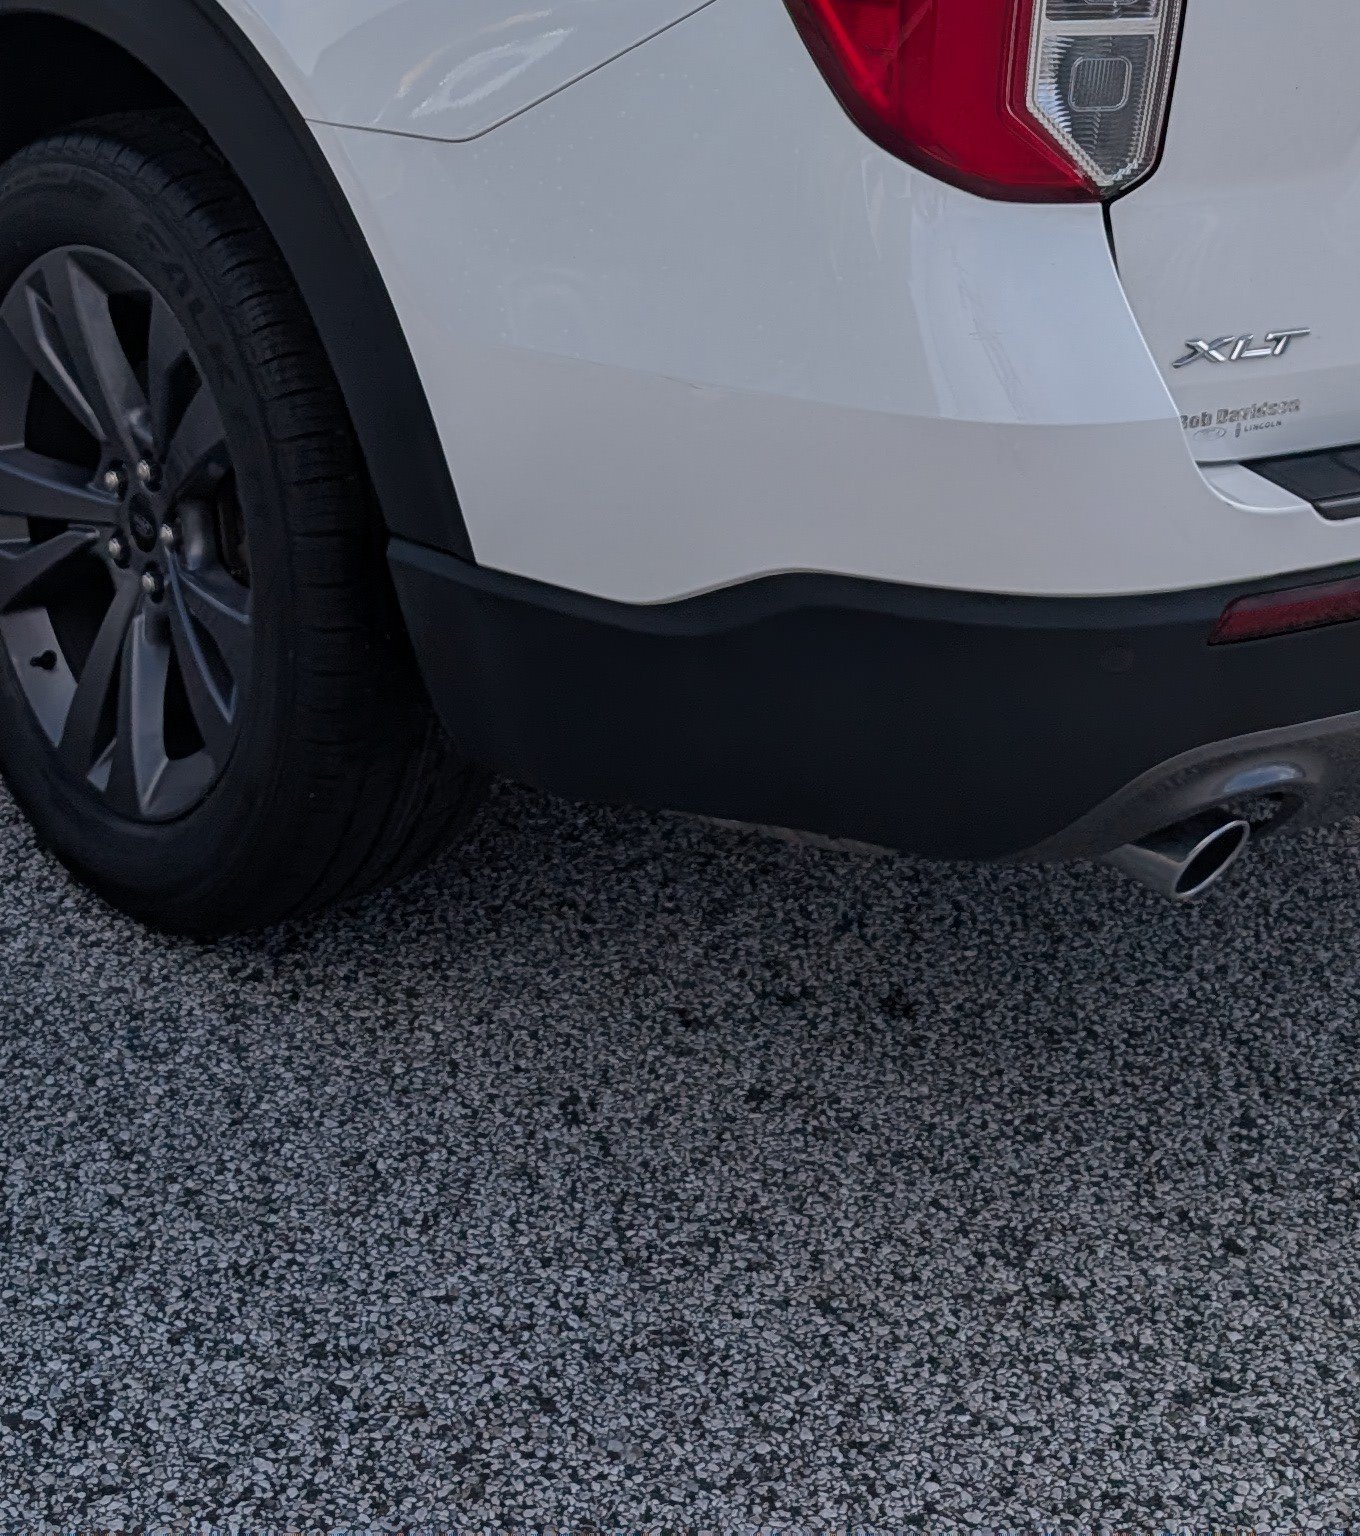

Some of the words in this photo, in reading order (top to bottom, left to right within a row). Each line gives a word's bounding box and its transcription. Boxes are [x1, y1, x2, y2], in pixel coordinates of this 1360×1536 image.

[1172, 327, 1311, 369] XLT
[1215, 398, 1301, 425] Davidson
[1243, 420, 1282, 433] LINCOLN
